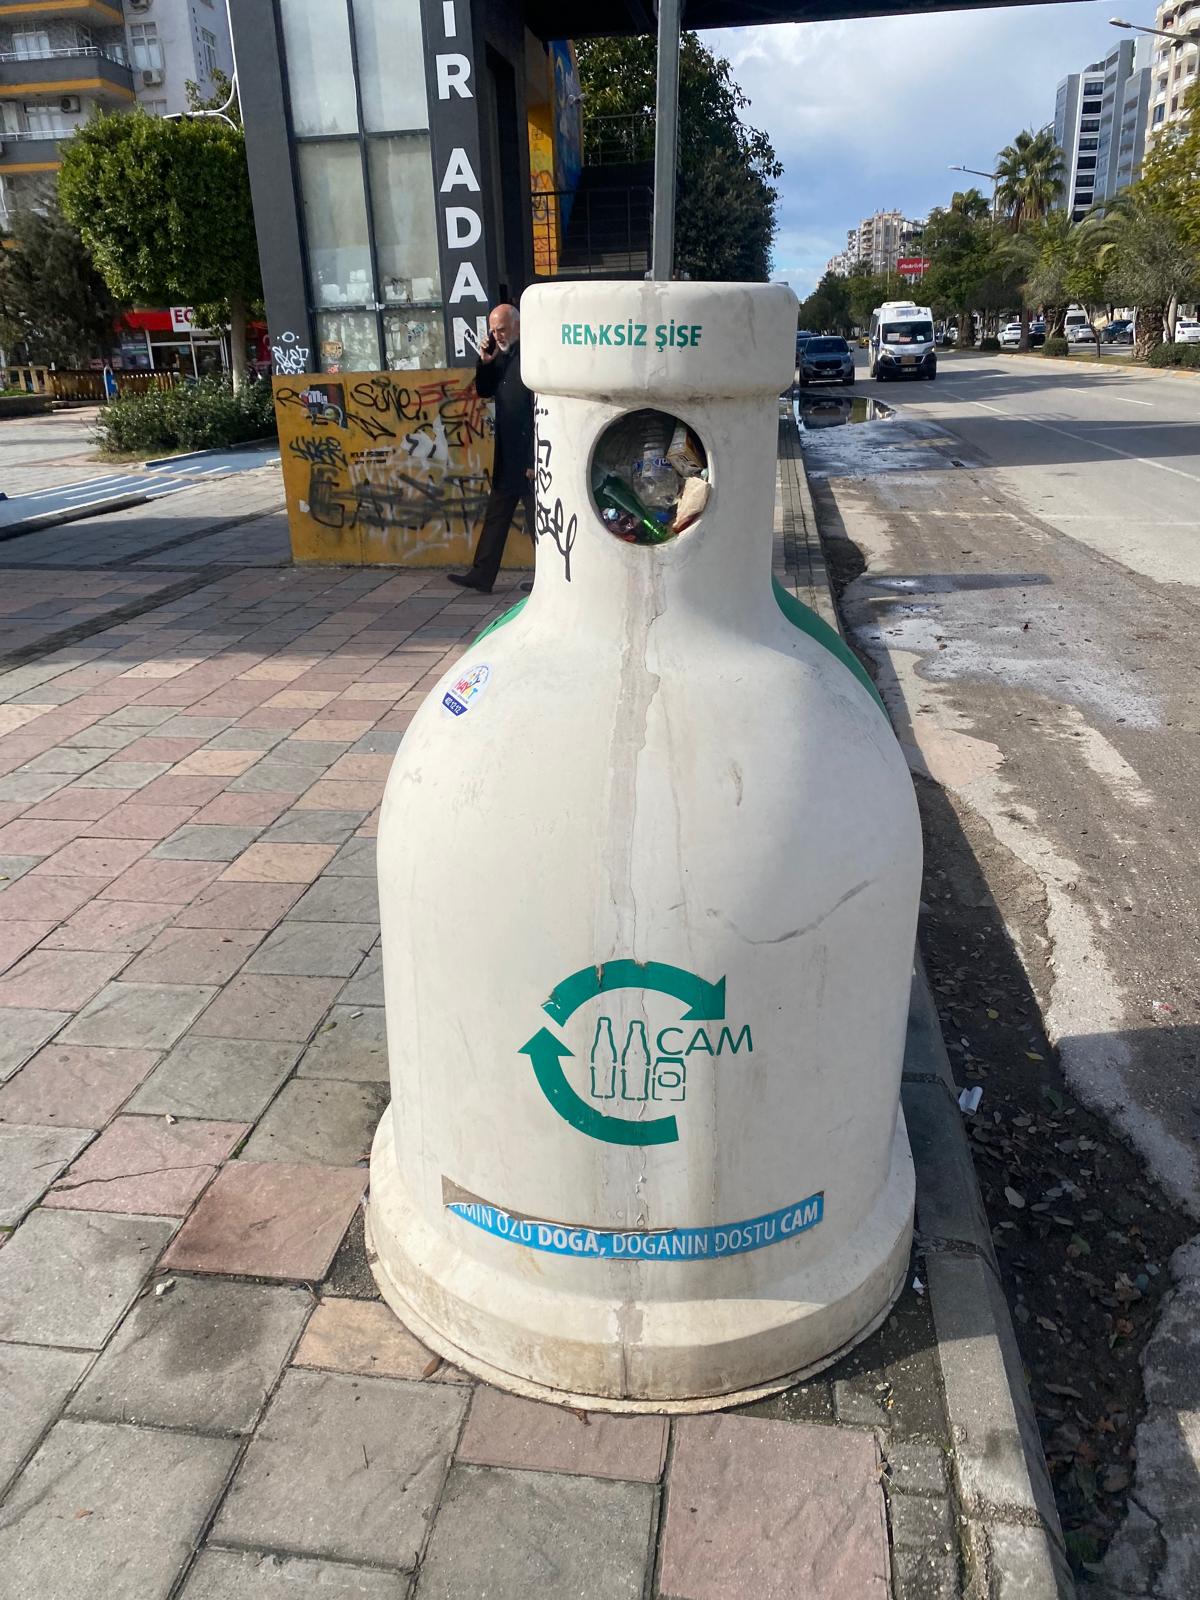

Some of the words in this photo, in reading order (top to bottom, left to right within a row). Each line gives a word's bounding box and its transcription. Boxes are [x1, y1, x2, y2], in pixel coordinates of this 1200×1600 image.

[561, 318, 648, 346] RENKSİZ
[655, 319, 703, 353] ŞİŞE
[656, 1024, 753, 1057] CAM
[714, 1219, 776, 1253] DOSTU
[780, 1200, 819, 1233] CAM
